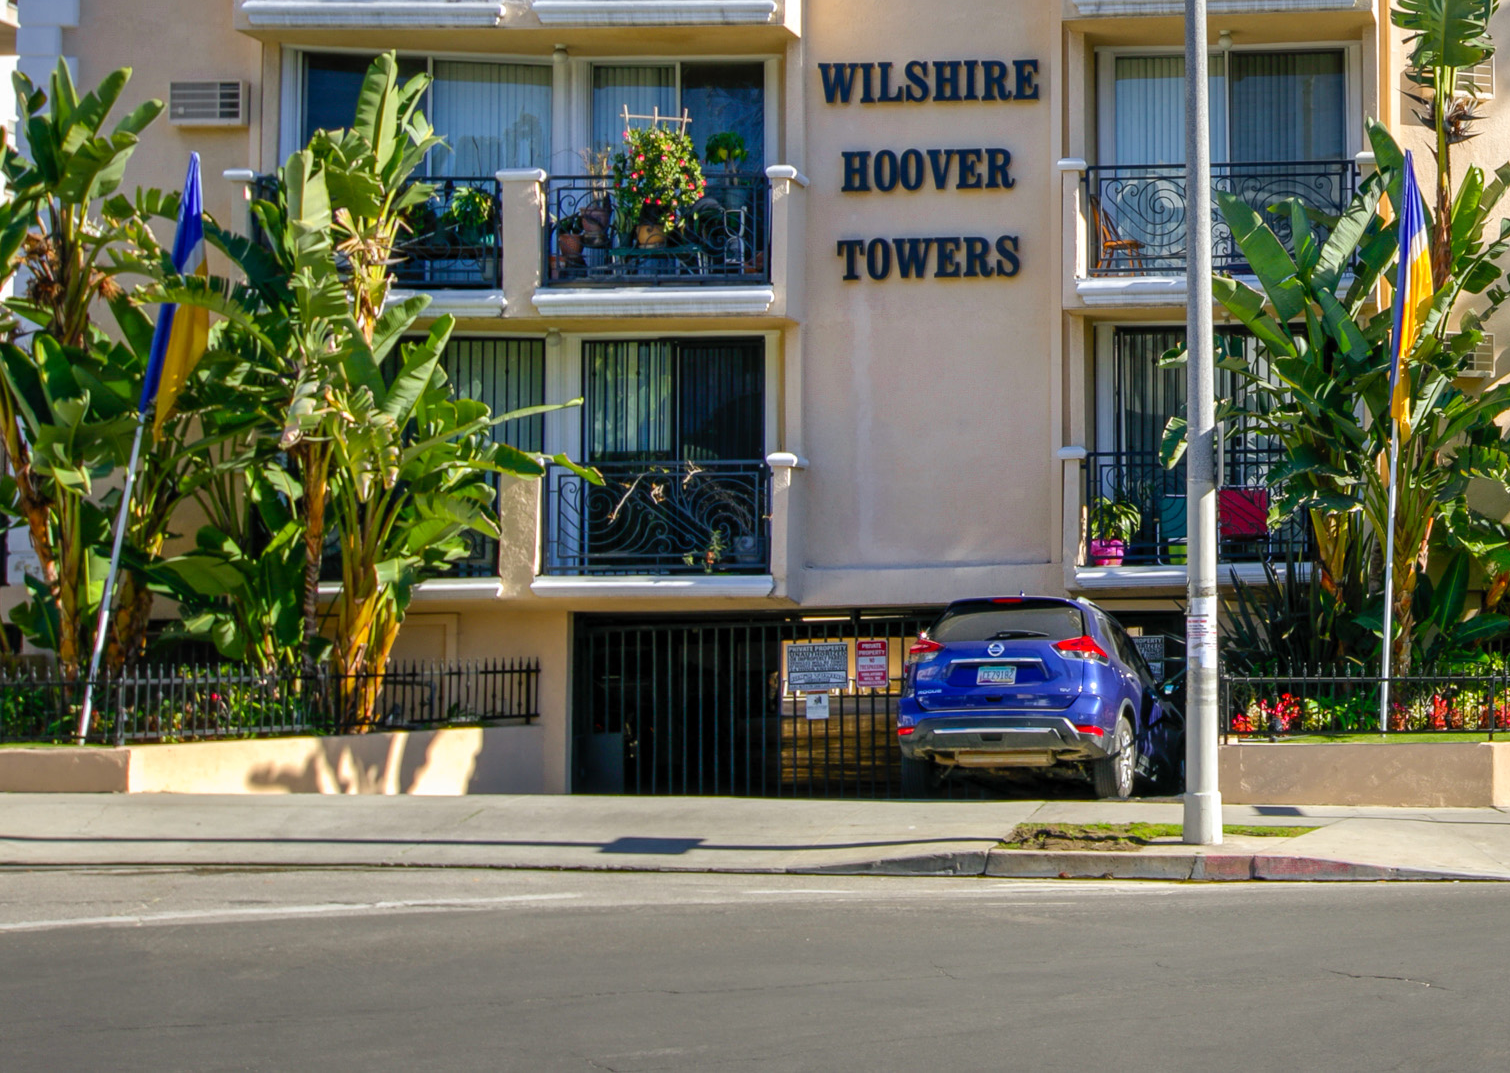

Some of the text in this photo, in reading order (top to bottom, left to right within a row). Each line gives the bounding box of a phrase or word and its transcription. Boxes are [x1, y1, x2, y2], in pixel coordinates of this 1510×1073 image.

[818, 59, 1040, 104] WILSHIRE
[841, 148, 1016, 192] HOOVER
[837, 235, 1021, 280] TOWERS
